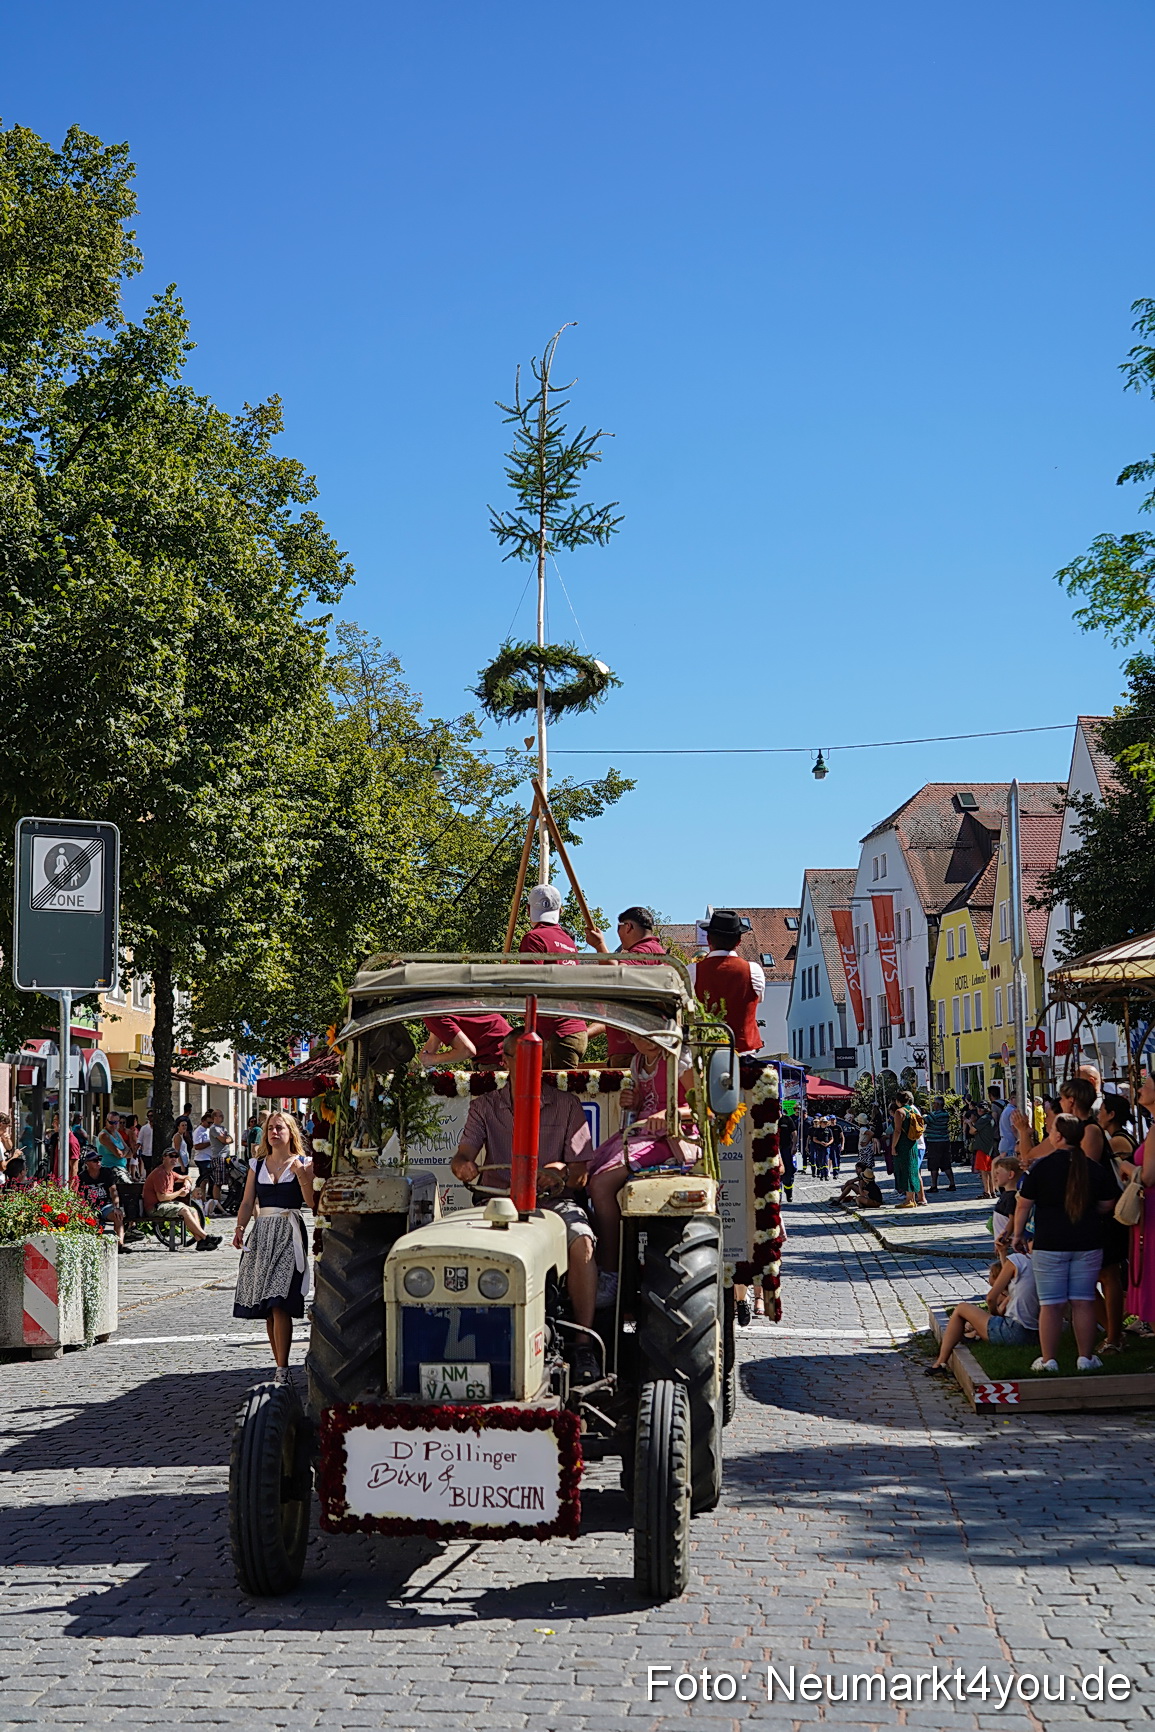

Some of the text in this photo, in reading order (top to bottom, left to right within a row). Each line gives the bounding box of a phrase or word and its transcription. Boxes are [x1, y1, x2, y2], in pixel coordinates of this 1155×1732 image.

[49, 894, 84, 907] ZONE
[878, 930, 898, 982] SALE
[954, 974, 969, 991] HOTEL
[722, 1152, 742, 1160] 2024
[442, 1366, 469, 1382] NM
[426, 1383, 486, 1400] VA 63
[438, 1464, 455, 1496] &
[449, 1485, 545, 1511] BURSCHN
